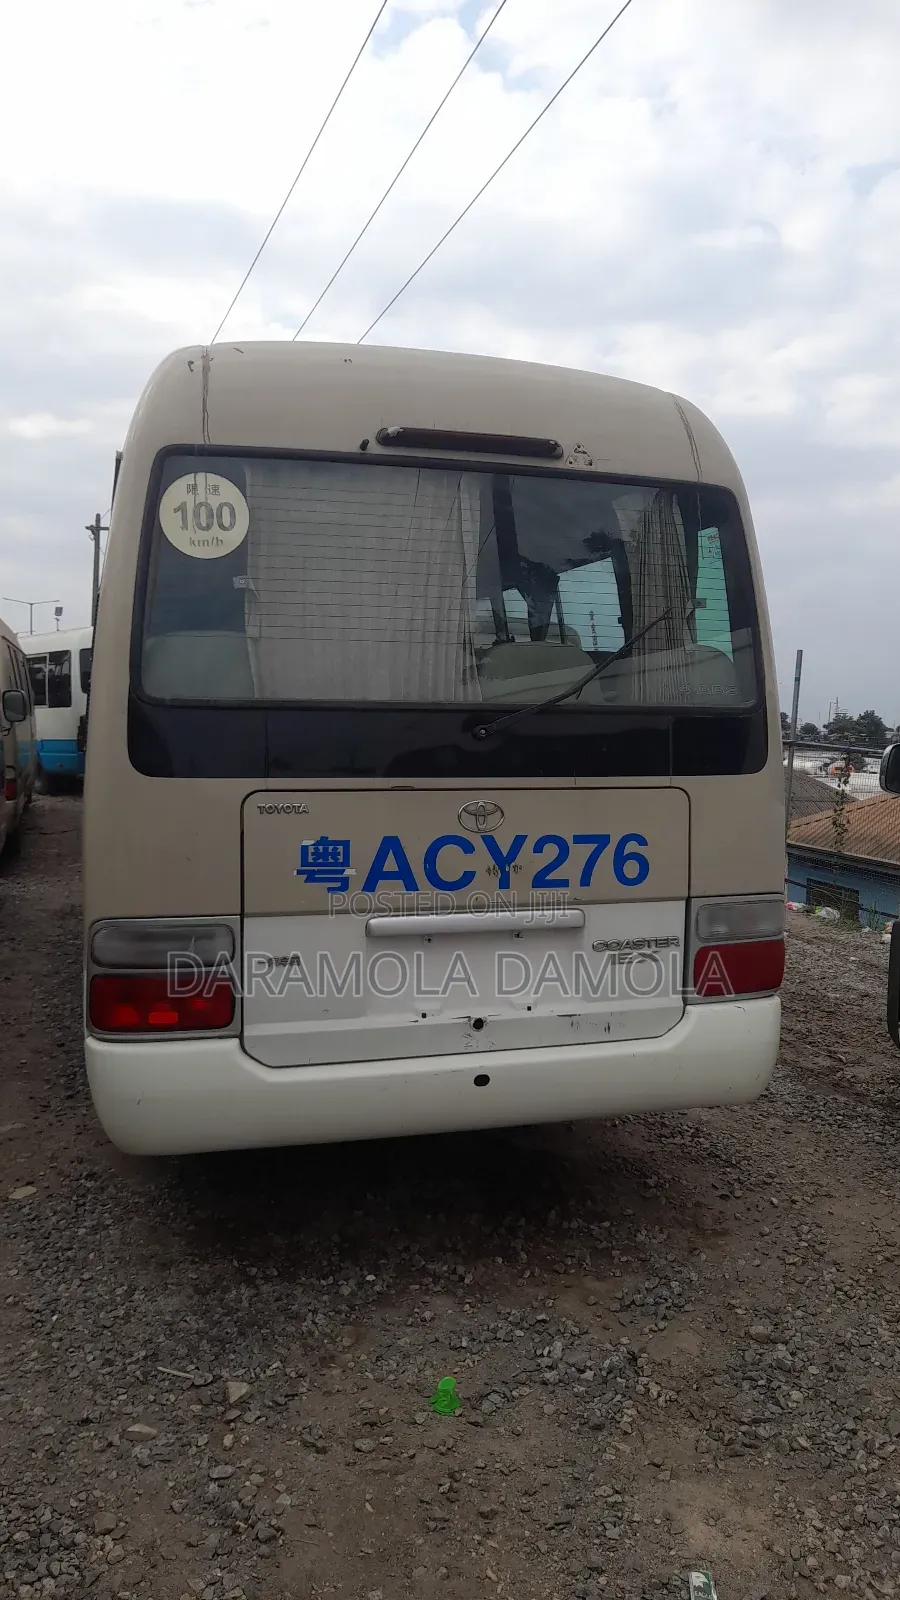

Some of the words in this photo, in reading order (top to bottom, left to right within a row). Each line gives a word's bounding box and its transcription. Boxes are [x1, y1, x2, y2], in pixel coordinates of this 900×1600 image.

[173, 501, 236, 532] 100
[189, 537, 224, 548] km/h
[257, 803, 309, 815] TOYOTA
[592, 936, 680, 952] COASTER
